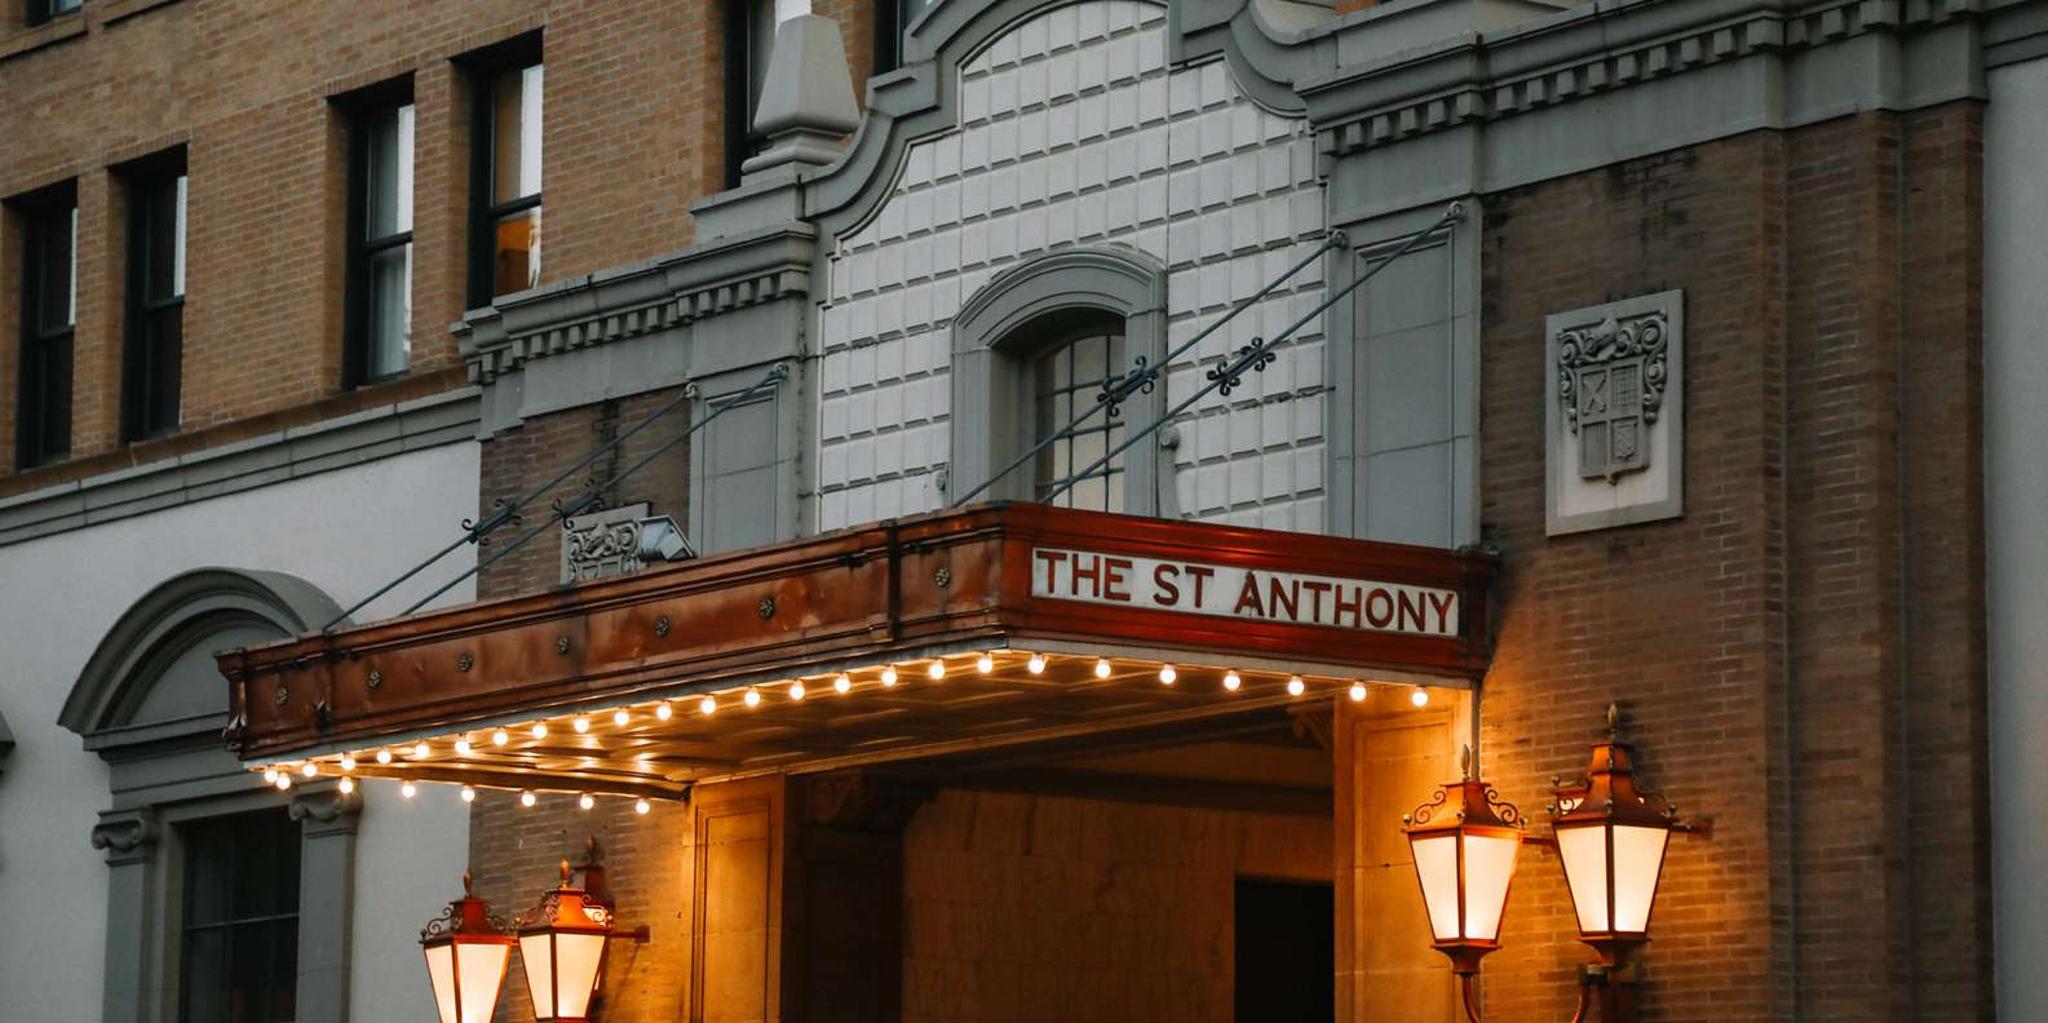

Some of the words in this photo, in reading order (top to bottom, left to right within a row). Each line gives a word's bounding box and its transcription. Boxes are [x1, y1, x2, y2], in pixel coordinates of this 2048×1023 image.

[1036, 550, 1133, 602] THE
[1152, 564, 1215, 608] ST
[1233, 570, 1455, 633] ANTHONY
